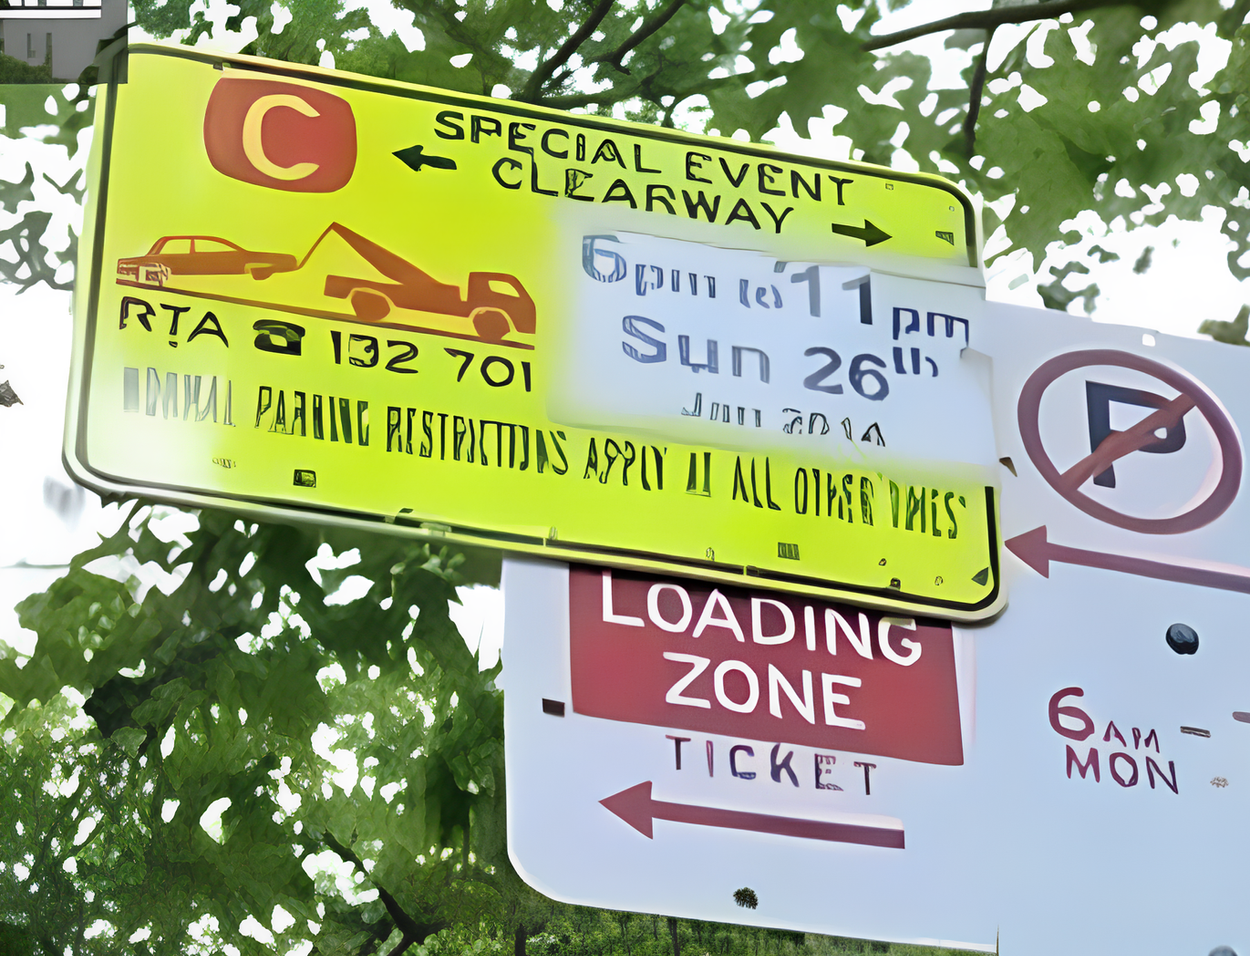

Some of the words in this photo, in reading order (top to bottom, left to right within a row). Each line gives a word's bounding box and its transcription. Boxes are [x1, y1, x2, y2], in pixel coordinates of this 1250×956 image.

[242, 95, 320, 181] C
[435, 110, 661, 174] SPECIAL
[685, 152, 854, 205] EVENT
[492, 157, 794, 234] CLEARWAY
[119, 296, 229, 348] RTA
[444, 348, 532, 392] 701
[622, 315, 770, 385] Sun
[732, 455, 781, 511] ALL
[602, 568, 922, 666] LOADING
[663, 651, 866, 731] ZONE
[665, 734, 877, 796] TICKET
[1066, 744, 1179, 794] MON
